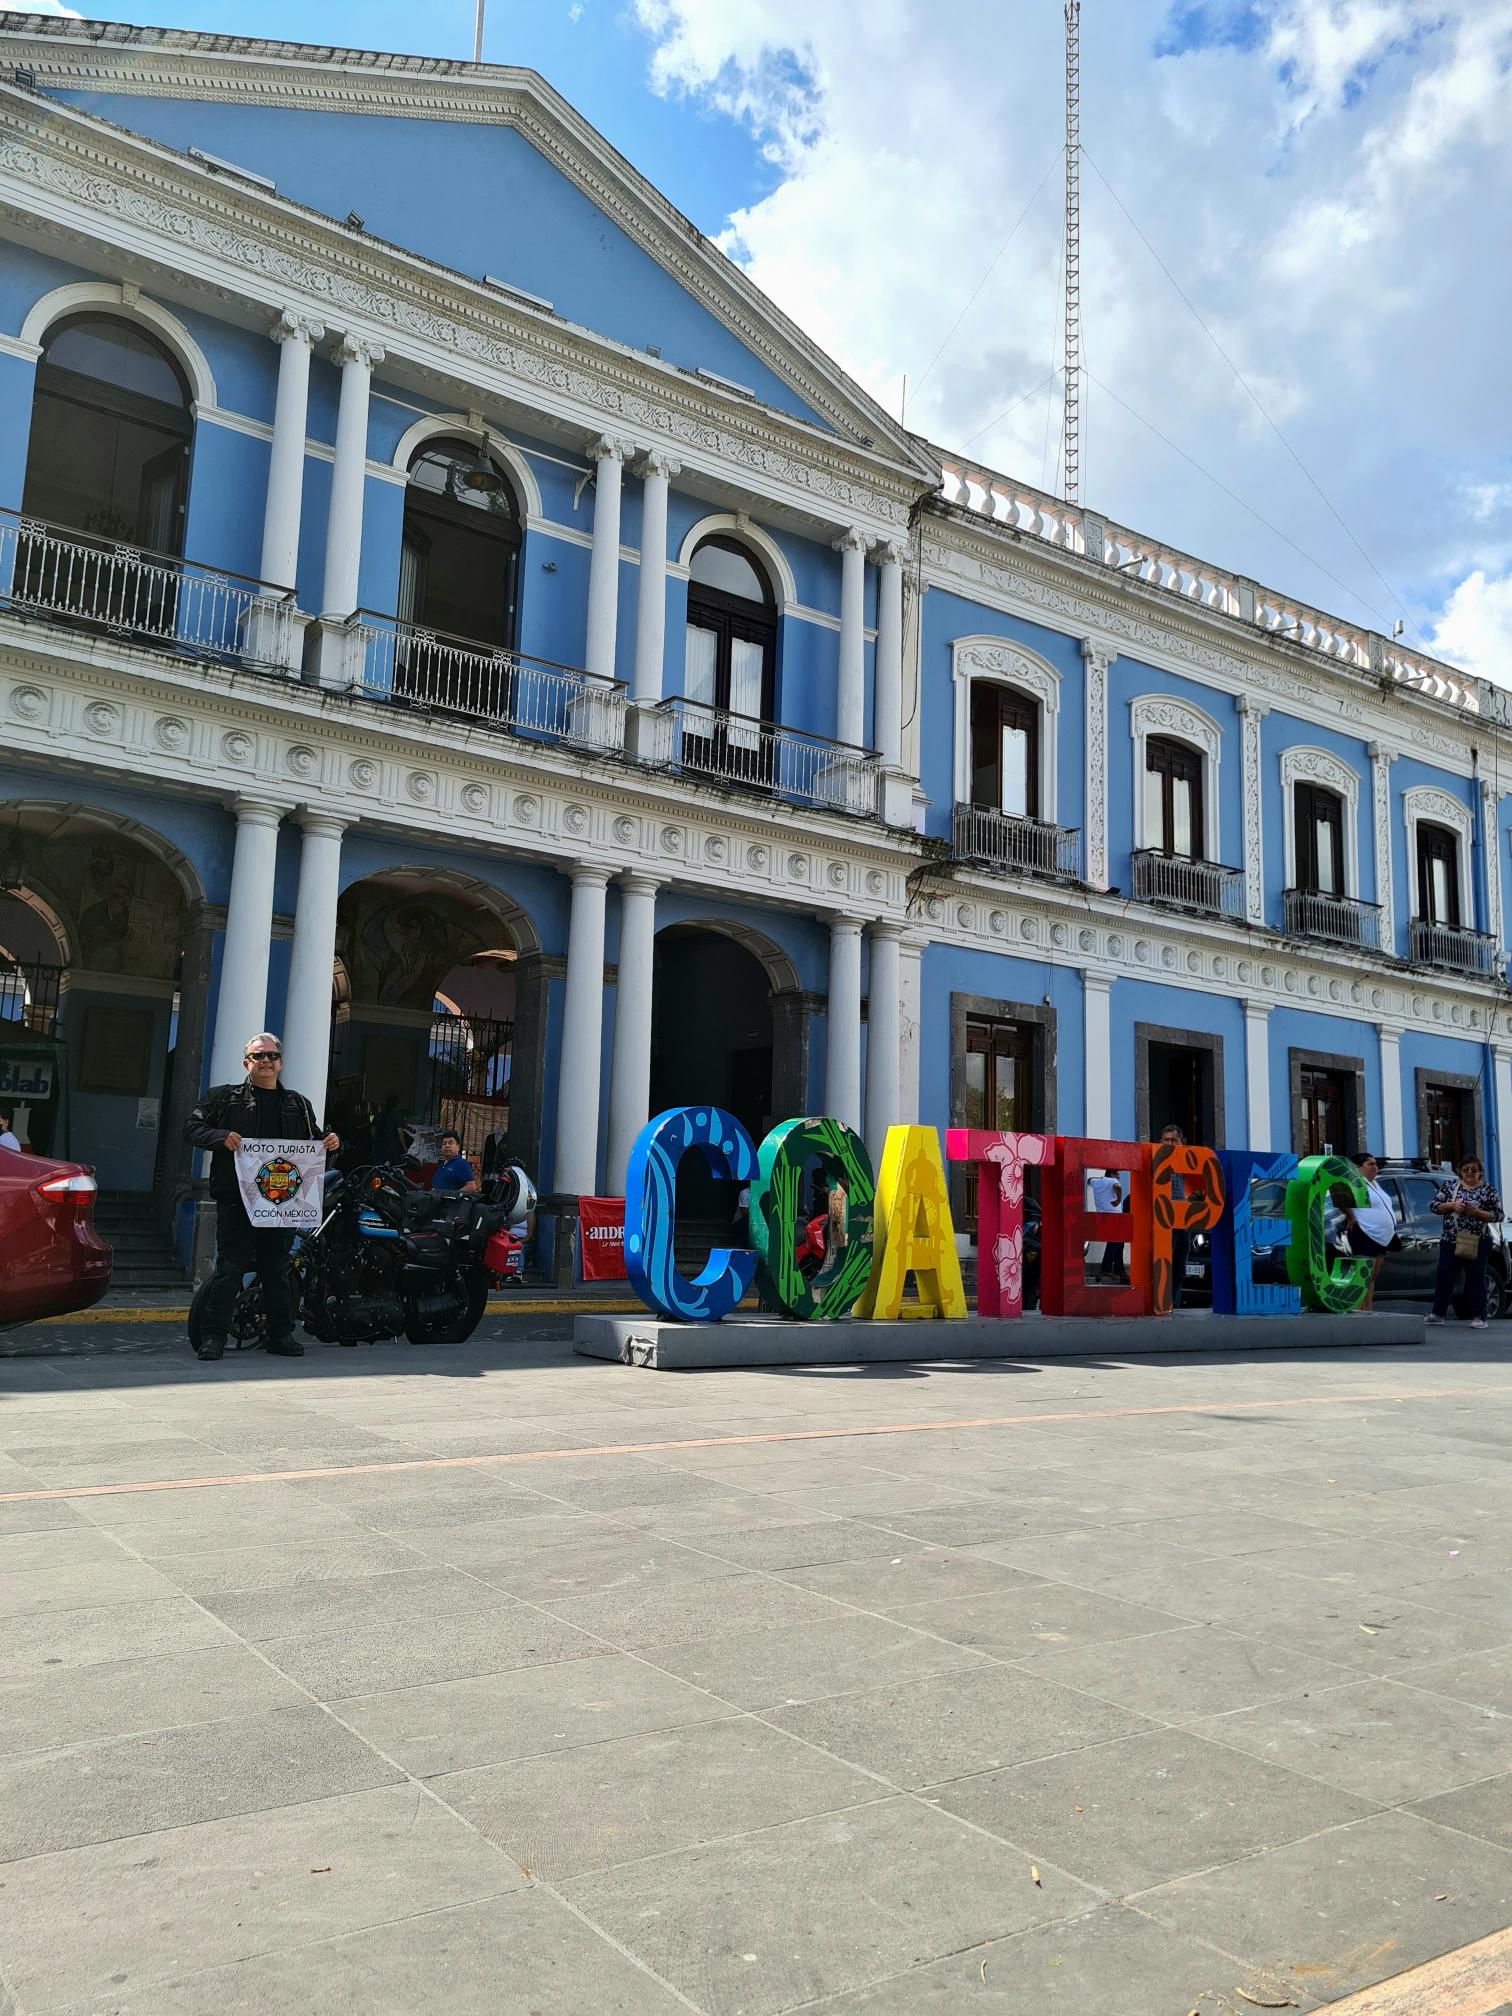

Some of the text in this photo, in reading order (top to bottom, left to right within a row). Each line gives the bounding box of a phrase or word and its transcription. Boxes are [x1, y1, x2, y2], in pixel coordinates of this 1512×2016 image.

[243, 1144, 316, 1154] MOTO TURISTA
[284, 1208, 318, 1218] MÉXICO
[625, 1105, 1374, 1322] COATEPEC
